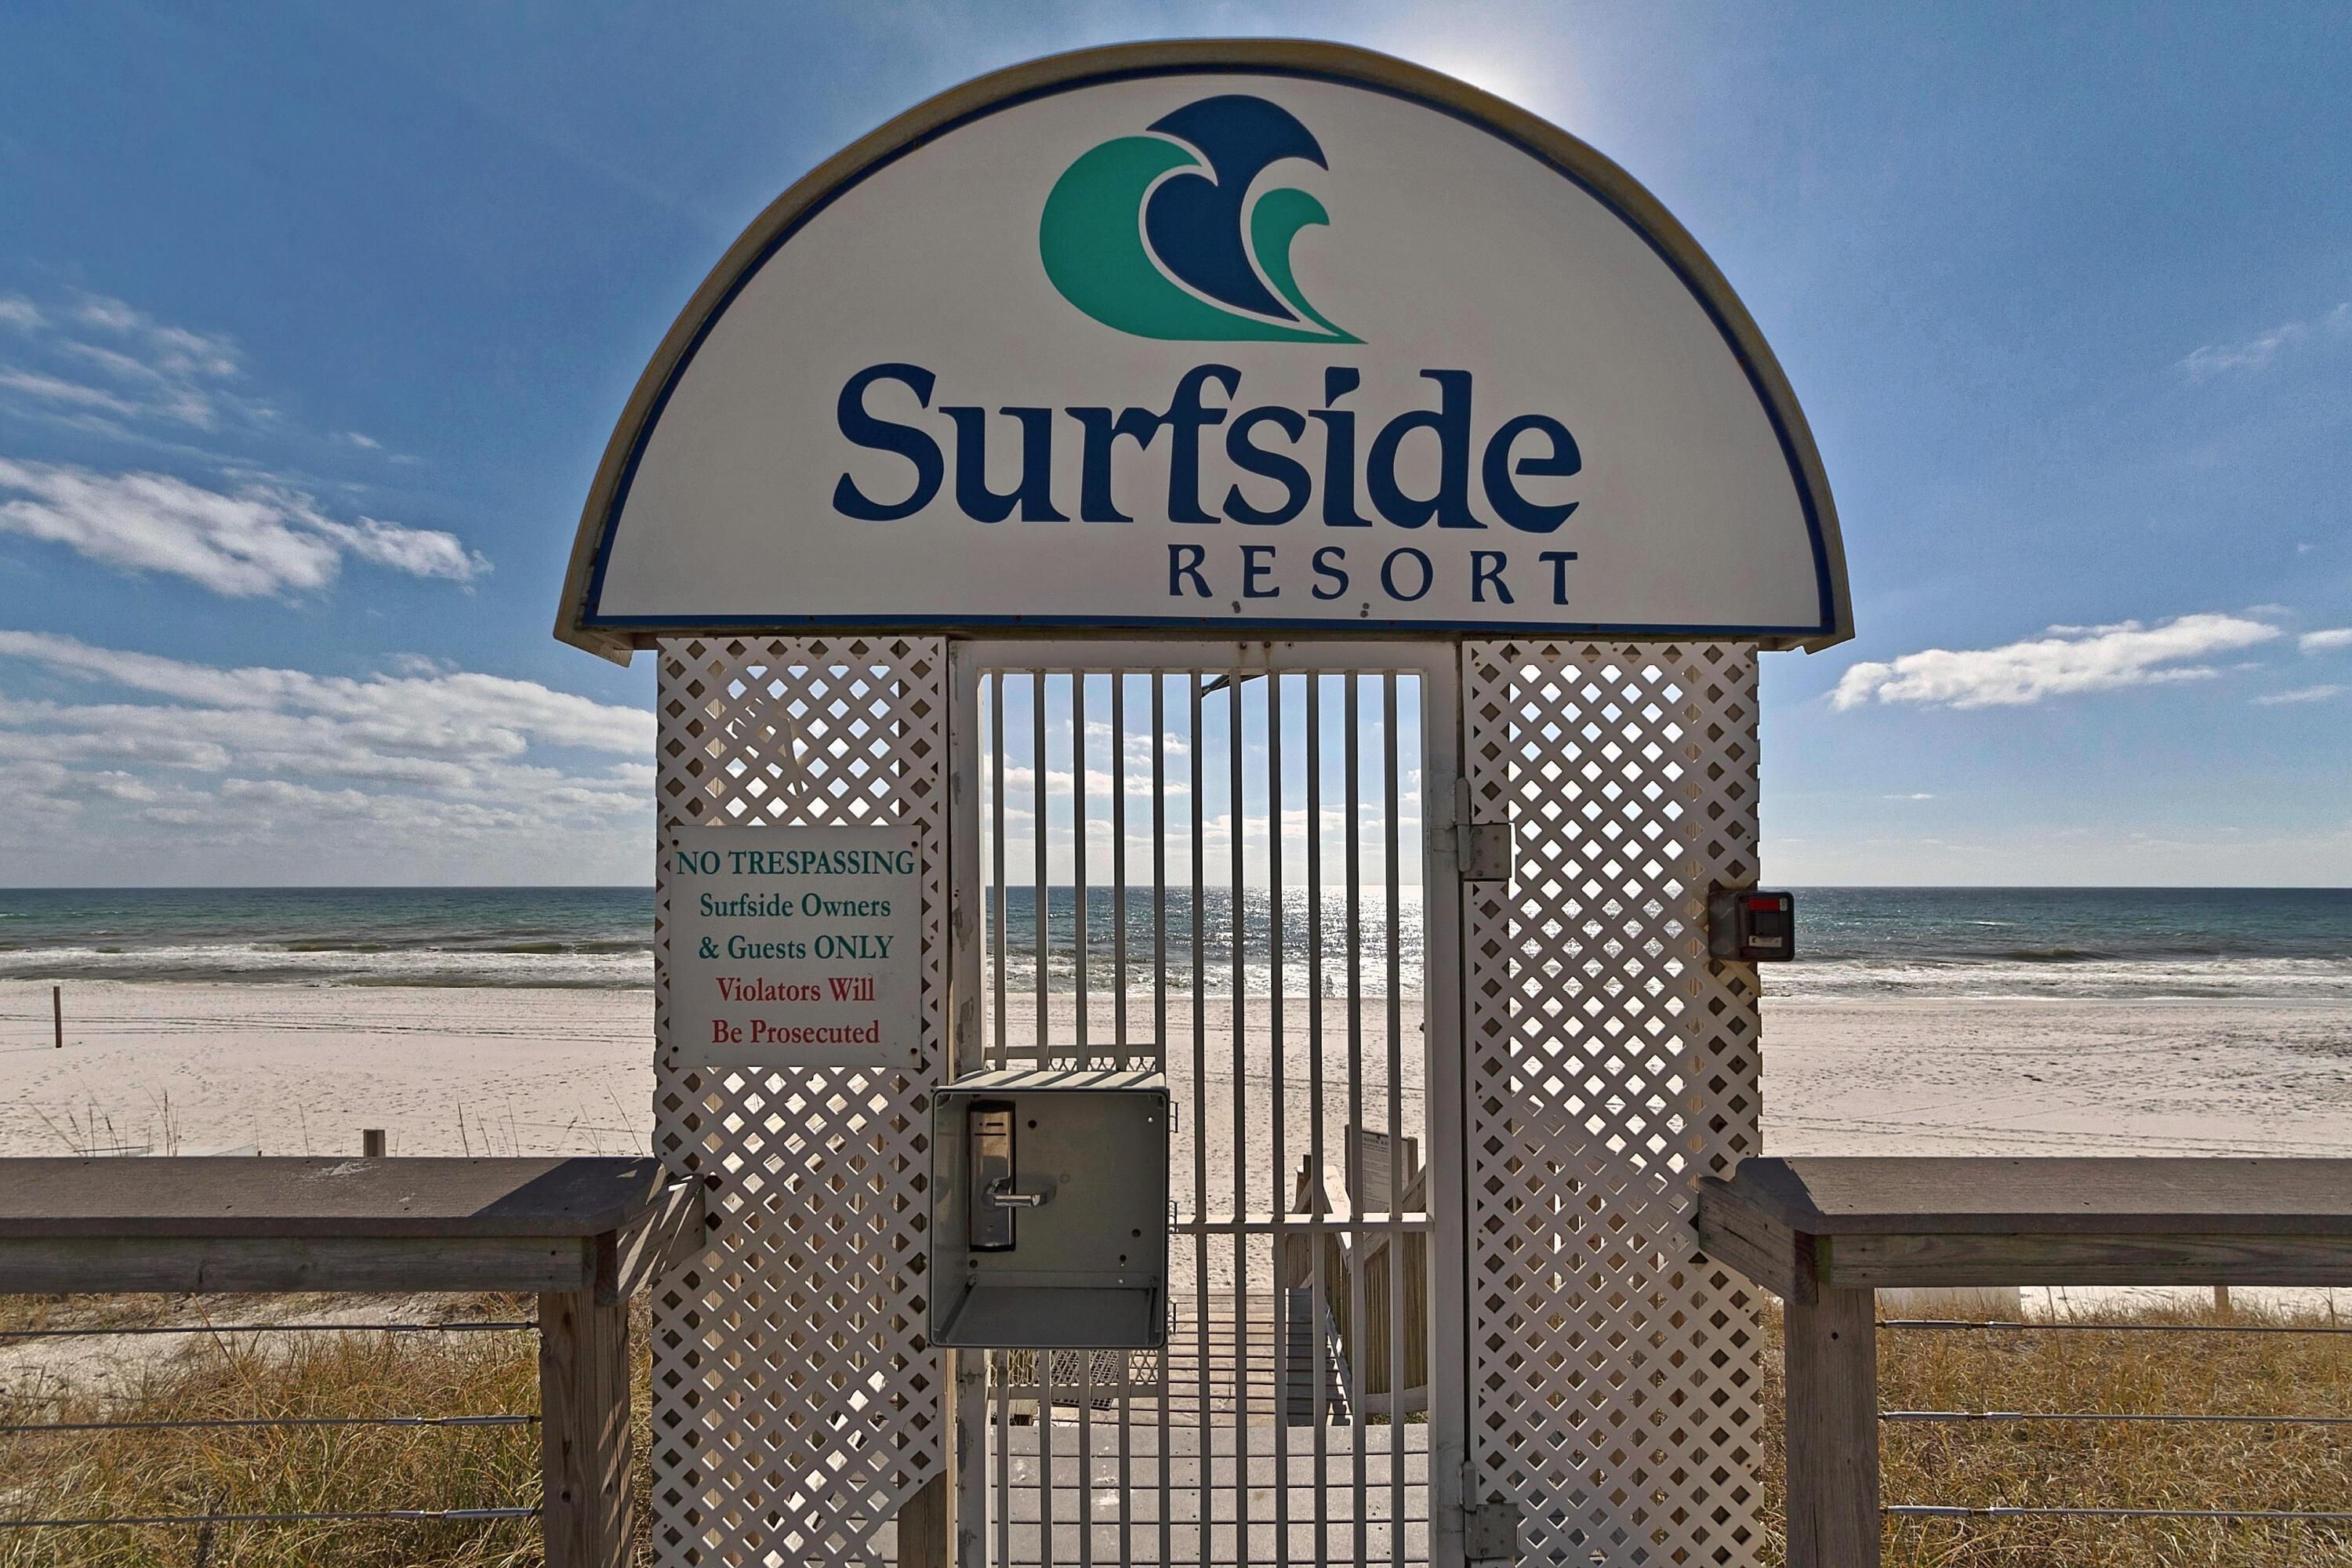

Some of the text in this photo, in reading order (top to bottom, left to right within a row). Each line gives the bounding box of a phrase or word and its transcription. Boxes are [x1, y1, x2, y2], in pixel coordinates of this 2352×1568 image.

[833, 363, 1581, 533] Surfside
[1167, 544, 1579, 604] RESORT
[676, 851, 915, 874] NO TRESPASSING
[700, 893, 891, 916] Surfside Owners
[699, 935, 894, 959] & Guests ONLY
[716, 978, 875, 1001] Violators Will
[712, 1019, 880, 1044] Be Prosecuted
